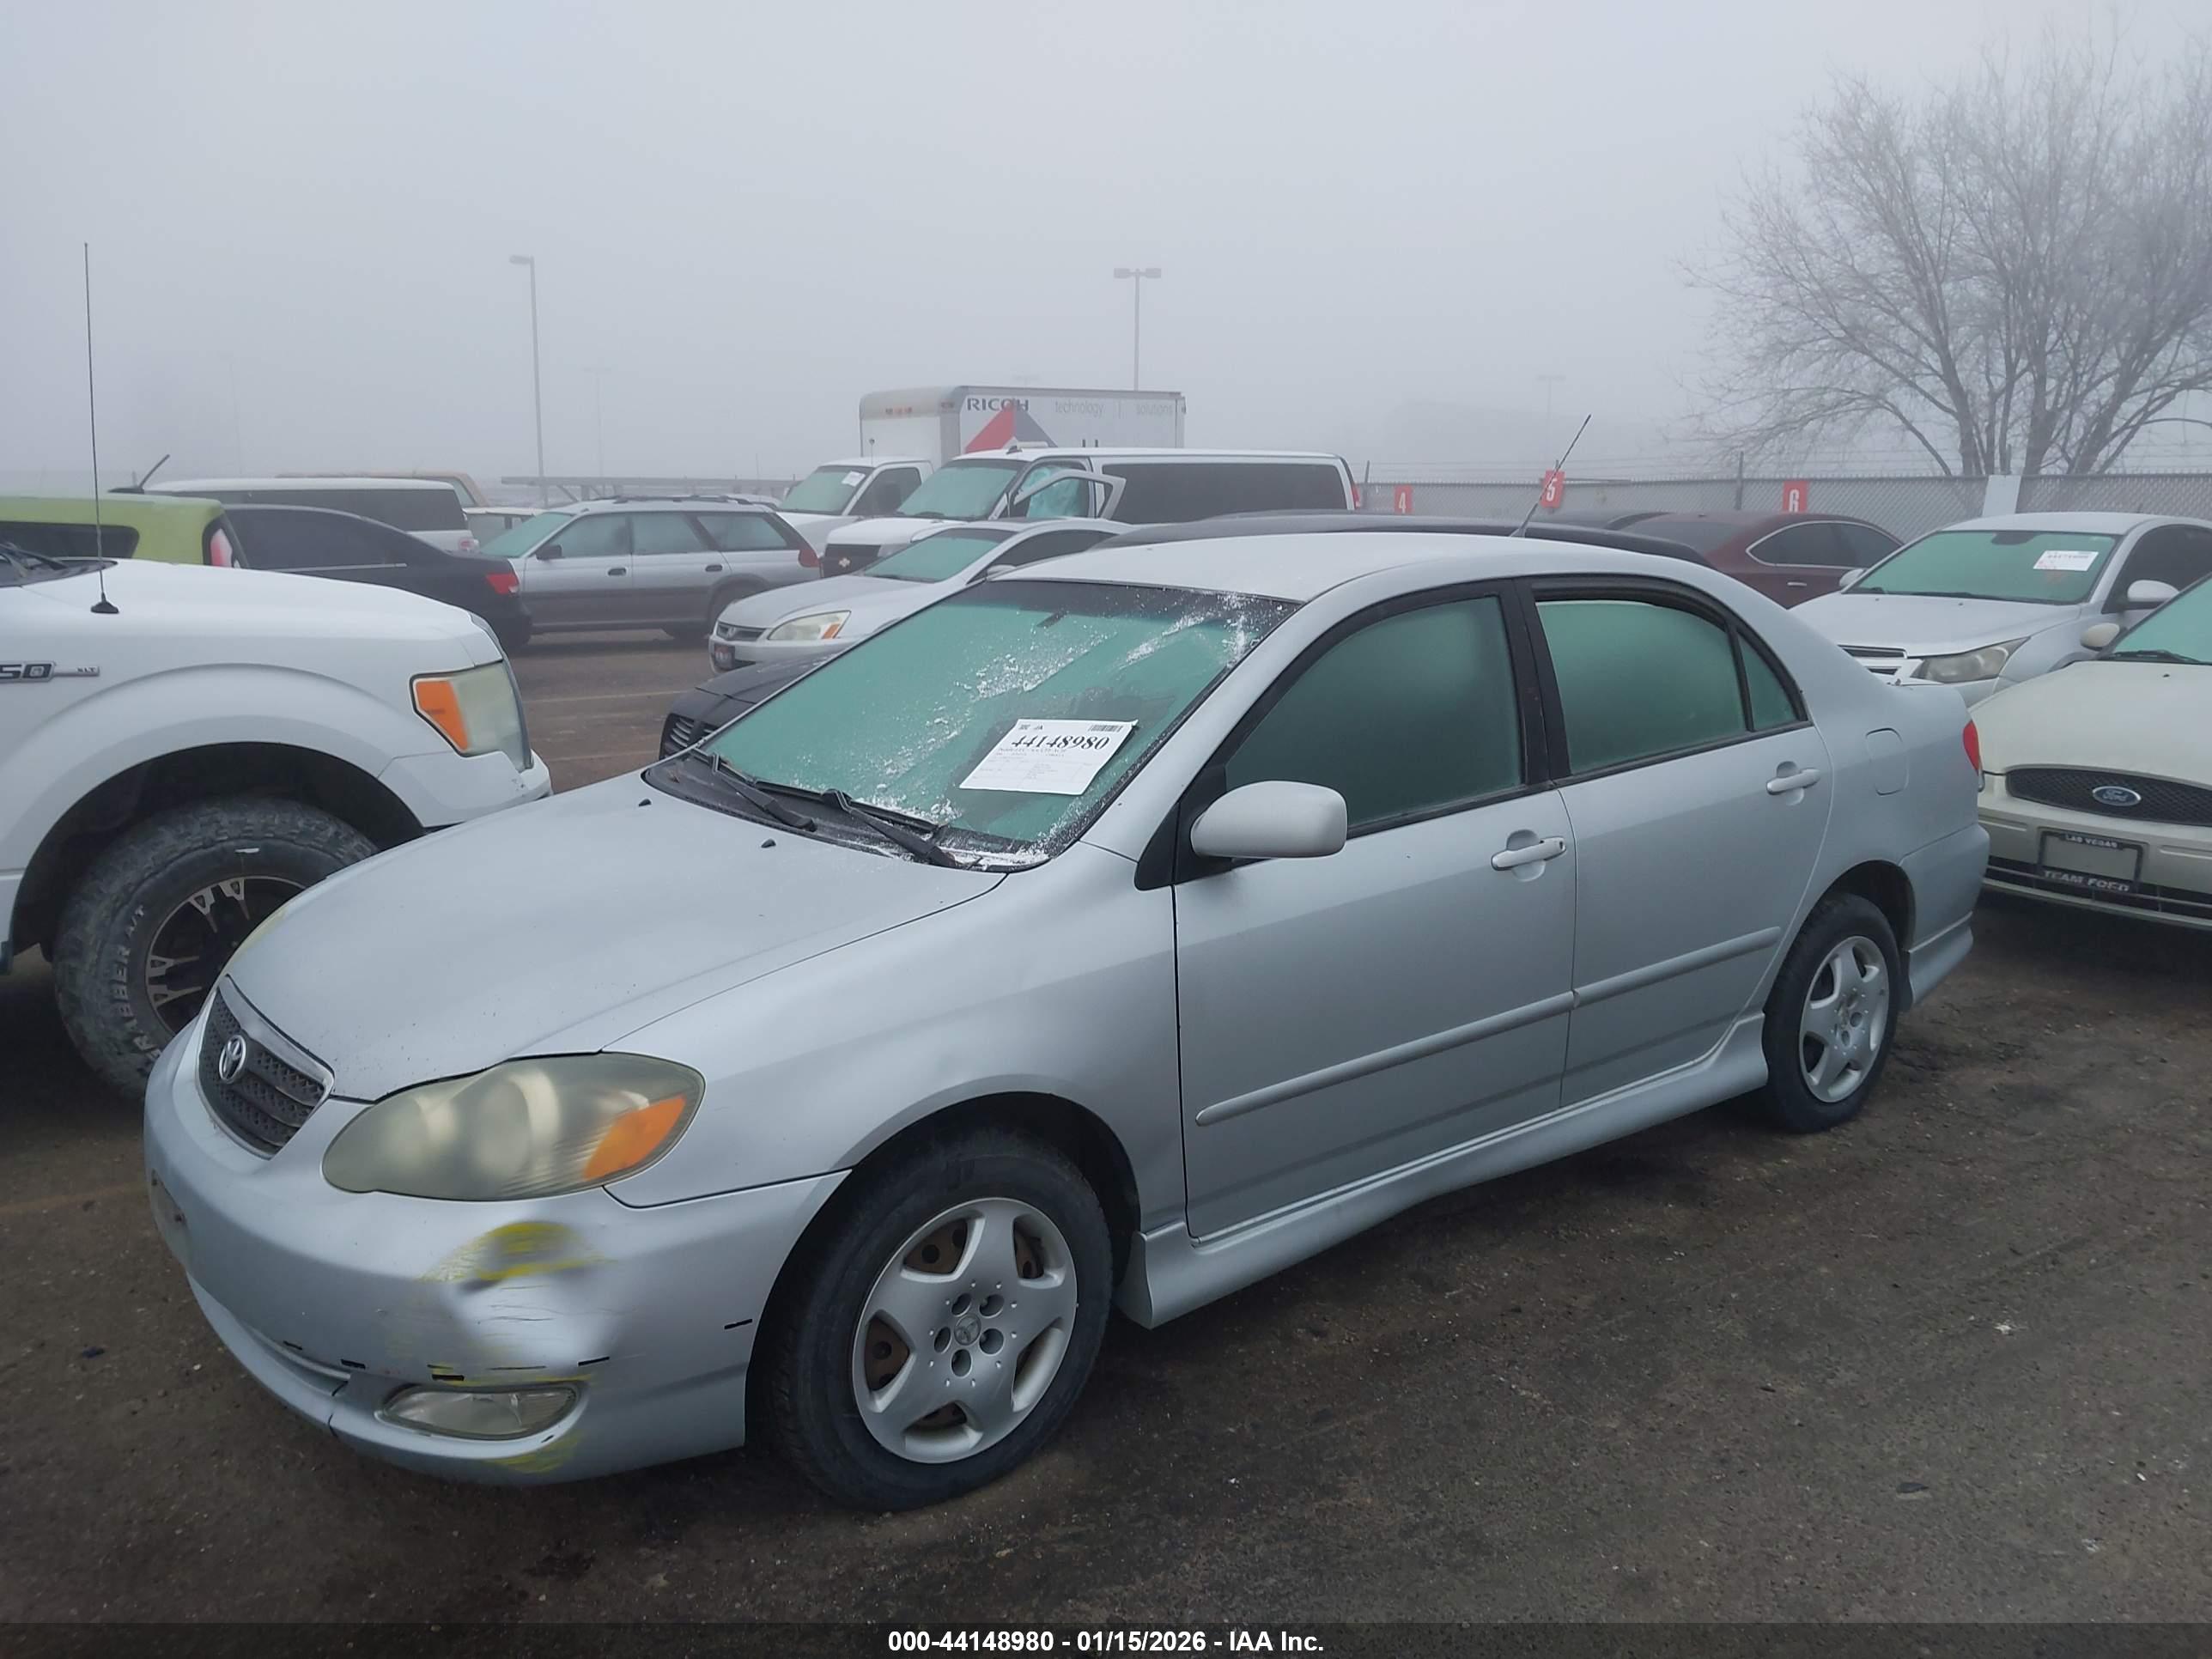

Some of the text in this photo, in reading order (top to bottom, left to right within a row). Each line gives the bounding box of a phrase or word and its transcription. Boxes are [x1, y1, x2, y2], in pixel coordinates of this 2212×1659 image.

[967, 398, 1029, 411] RICOH
[1054, 401, 1104, 418] technology
[1546, 477, 1558, 502] 5
[1398, 491, 1407, 514] 4
[1789, 489, 1800, 513] 6
[1012, 735, 1110, 750] 44148980
[2064, 833, 2118, 848] LAS VEGAS
[2044, 869, 2130, 892] TEAM FORD
